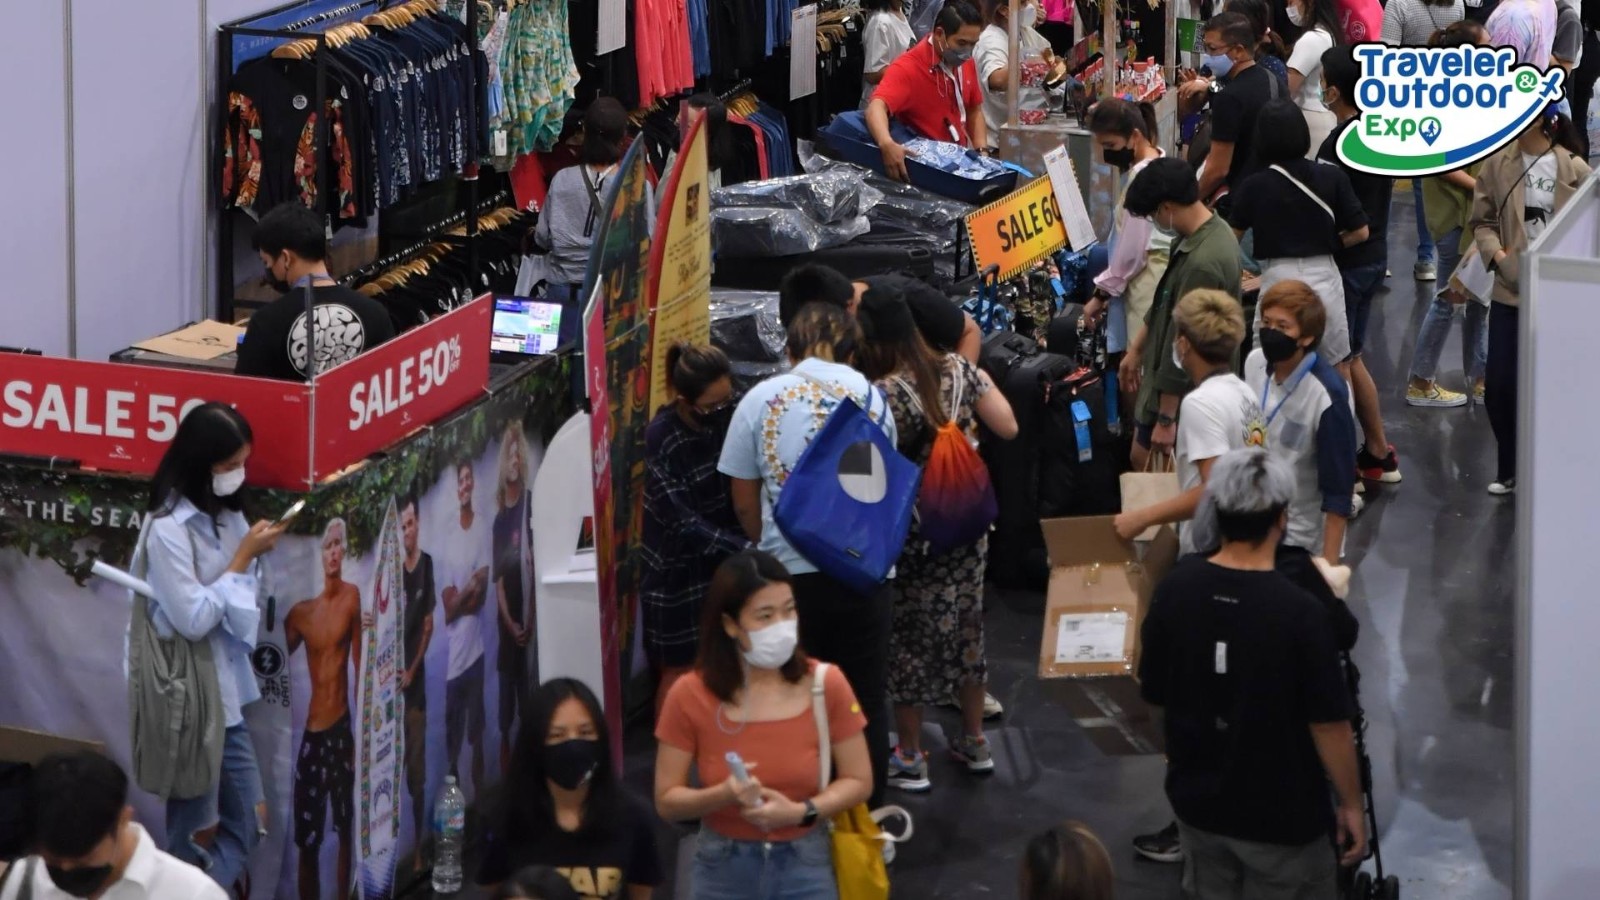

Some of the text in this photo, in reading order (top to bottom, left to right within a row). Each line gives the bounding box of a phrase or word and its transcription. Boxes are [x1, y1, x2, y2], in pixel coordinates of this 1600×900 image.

[996, 201, 1044, 253] SALE
[2, 380, 136, 439] SALE
[349, 356, 415, 431] SALE
[23, 500, 76, 523] THE
